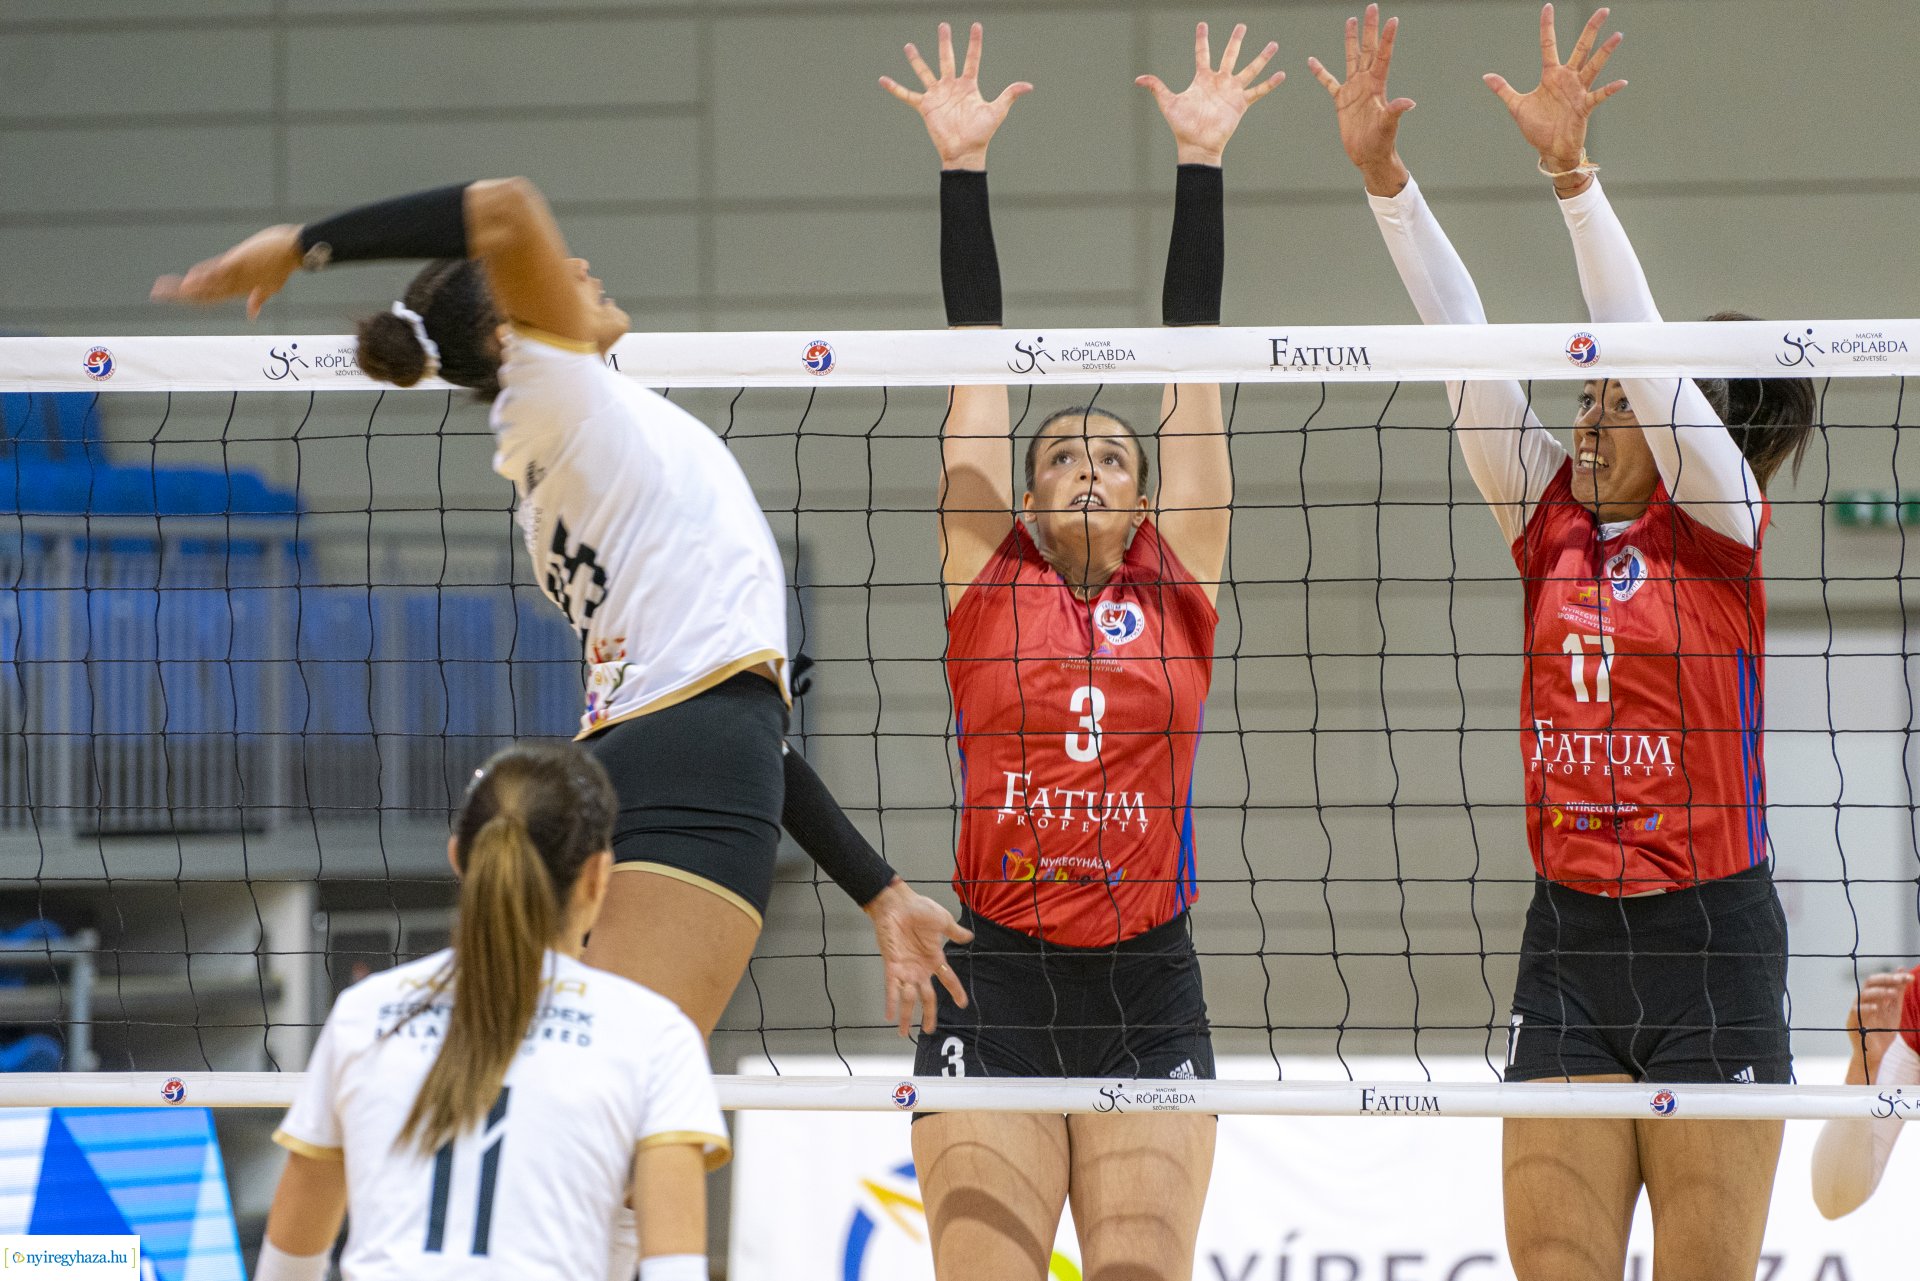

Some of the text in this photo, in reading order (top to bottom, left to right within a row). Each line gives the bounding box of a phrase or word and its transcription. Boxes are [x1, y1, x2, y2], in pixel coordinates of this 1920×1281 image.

[1061, 347, 1136, 361] RÖPLABDA
[1268, 335, 1371, 367] FATUM
[1831, 339, 1908, 353] RÖPLABDA
[315, 354, 358, 368] RÖPLA
[1562, 633, 1615, 703] 17
[1065, 686, 1106, 763] 3
[1531, 717, 1676, 765] FATUM
[1531, 762, 1676, 776] PROPERTY
[998, 770, 1149, 823] FATUM
[997, 814, 1149, 833] PROPERTY
[941, 1036, 965, 1078] 3
[1136, 1092, 1196, 1104] RÖPLABDA
[1360, 1086, 1440, 1112] FATUM
[424, 1086, 510, 1256] 11
